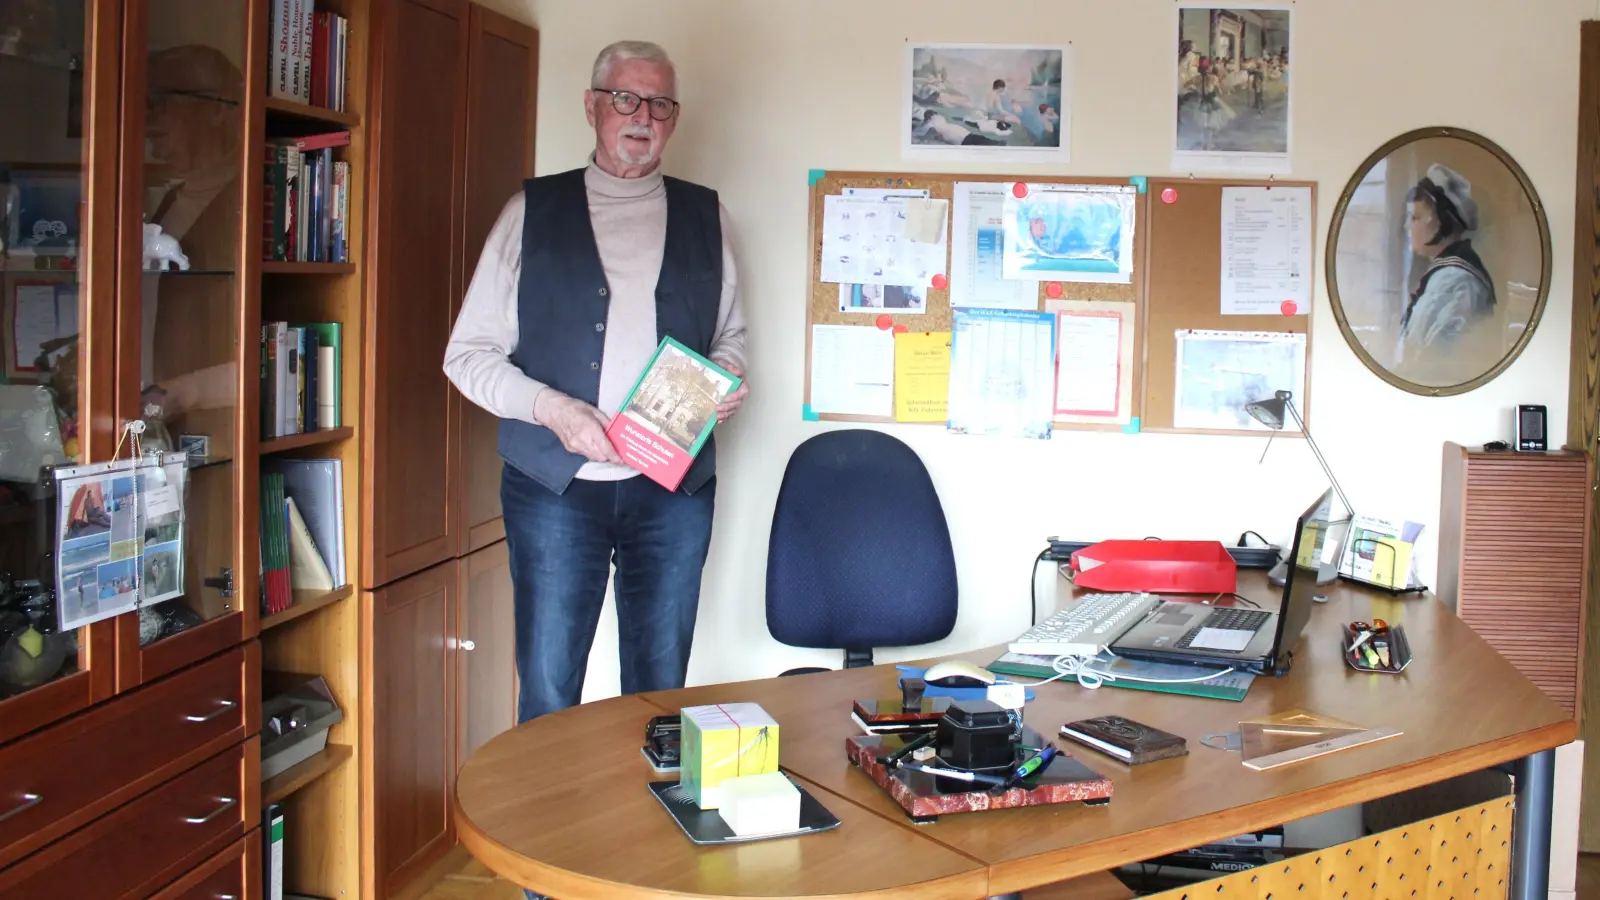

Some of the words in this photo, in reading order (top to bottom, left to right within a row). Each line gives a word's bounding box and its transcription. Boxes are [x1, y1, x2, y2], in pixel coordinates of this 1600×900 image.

[304, 13, 312, 61] Tai-Pan
[624, 424, 652, 445] Wunstorfs
[652, 442, 674, 458] Schulen
[1210, 862, 1254, 872] MEDIO
